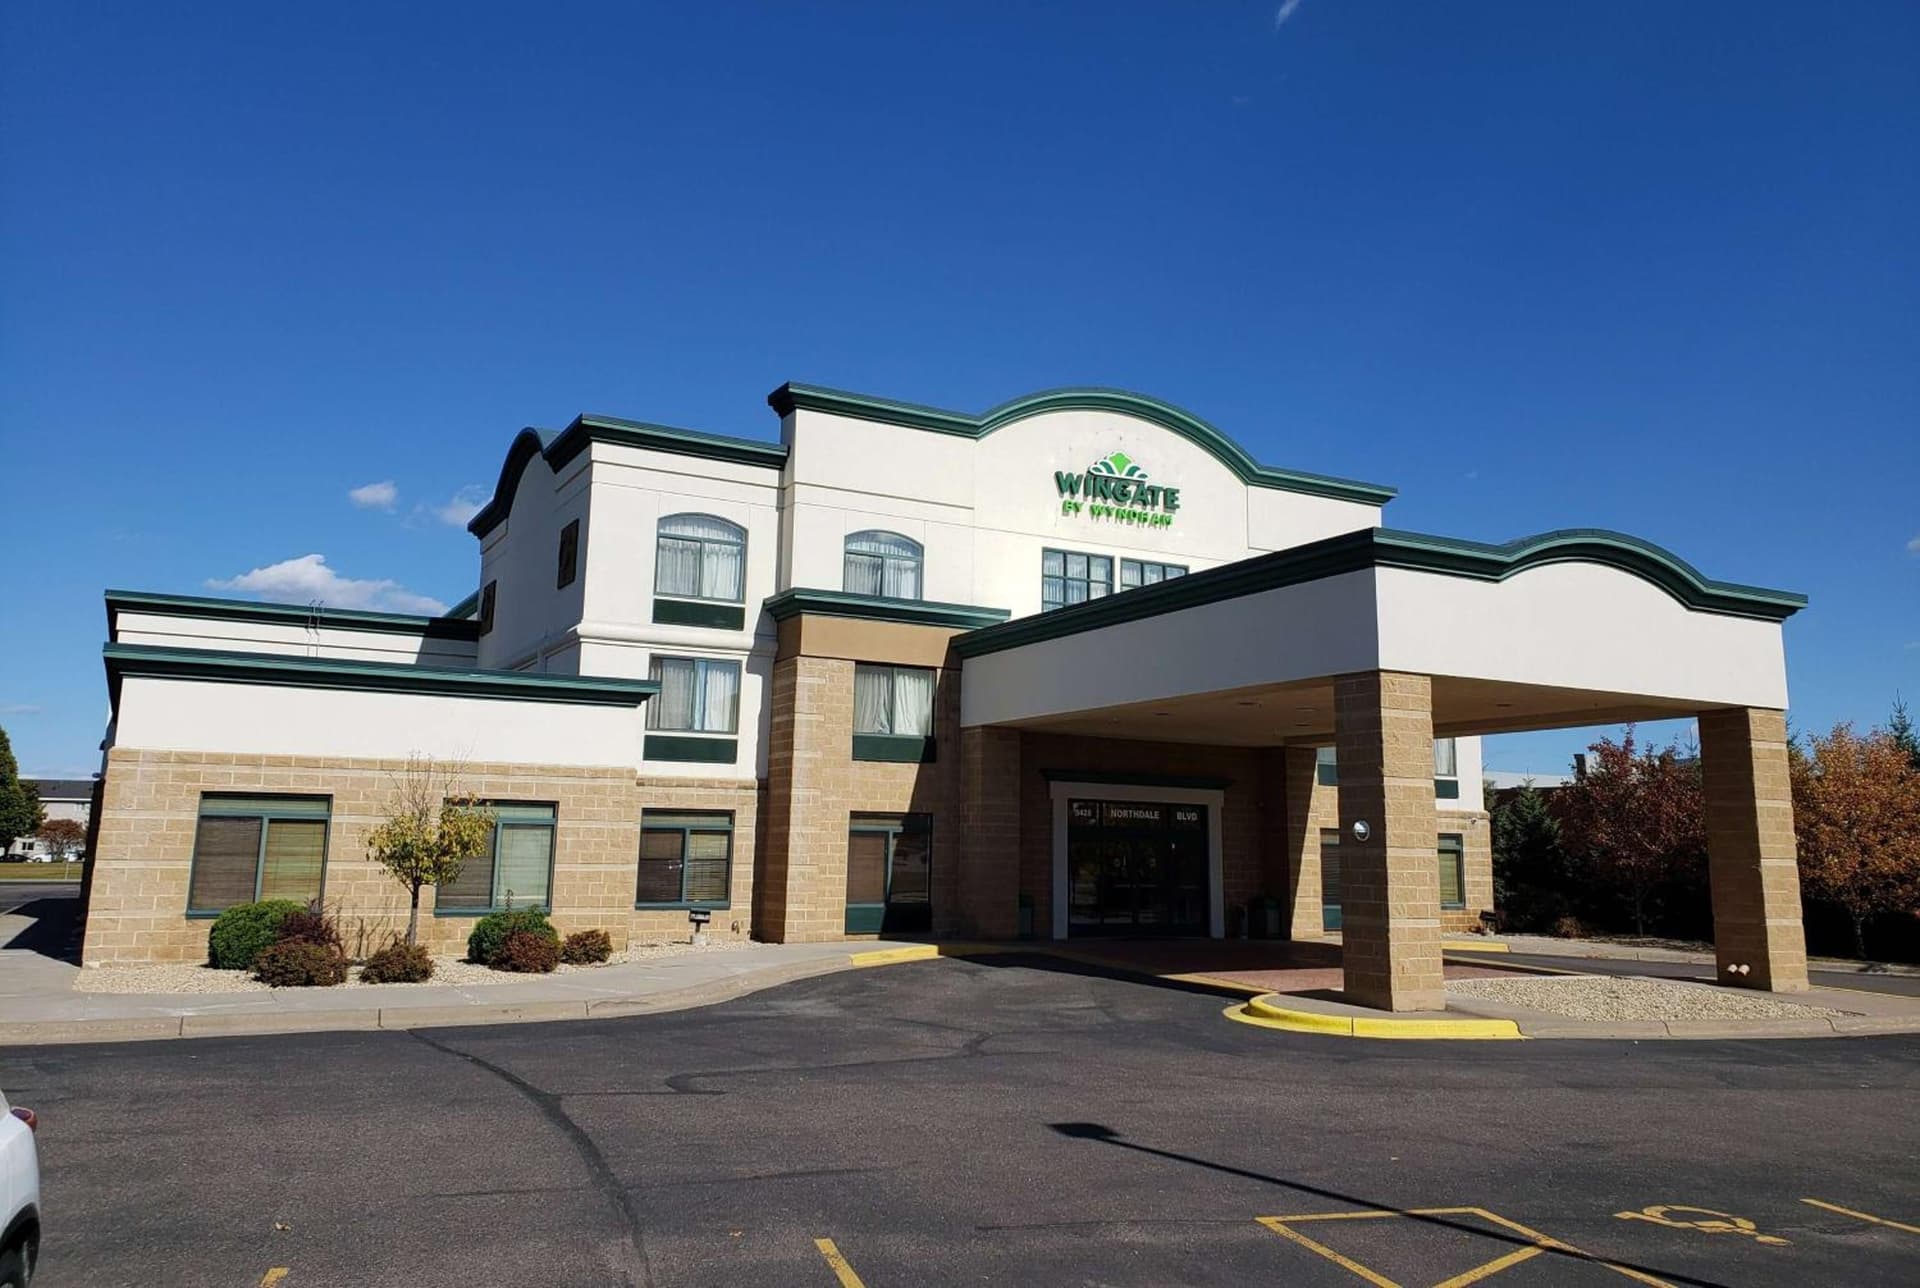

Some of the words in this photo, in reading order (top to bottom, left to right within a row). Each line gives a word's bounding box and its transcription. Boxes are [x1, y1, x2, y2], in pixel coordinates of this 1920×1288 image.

[1055, 471, 1180, 510] WINGATE
[1062, 500, 1084, 514] BY
[1089, 504, 1173, 527] WYNDHAM
[1110, 808, 1160, 820] NORTHDALE
[1176, 811, 1198, 821] BLVD
